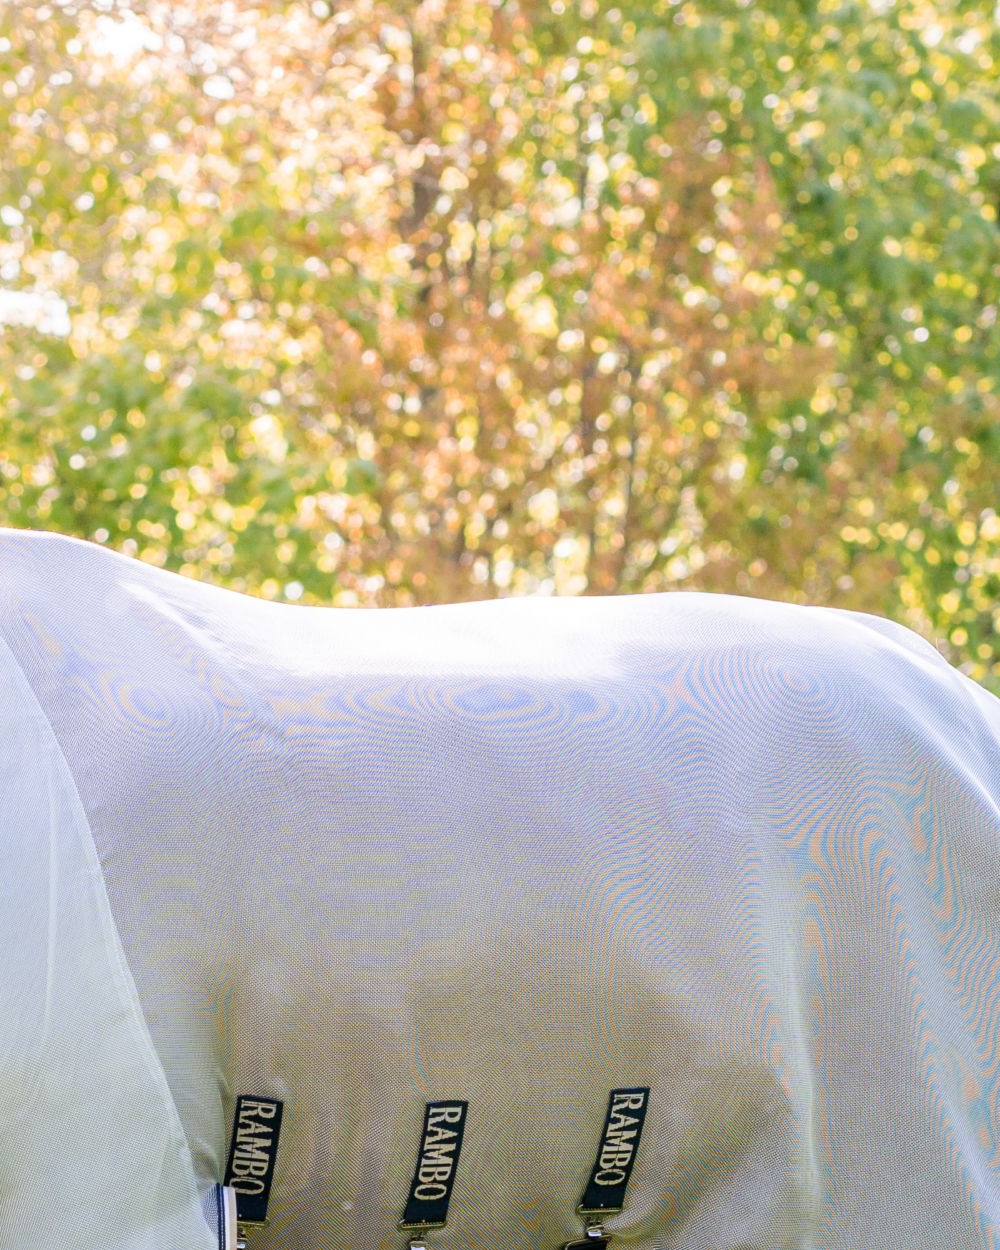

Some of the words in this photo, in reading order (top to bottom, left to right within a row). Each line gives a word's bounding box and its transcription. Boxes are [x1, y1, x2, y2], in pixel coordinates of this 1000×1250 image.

[229, 1100, 277, 1195] RAMBO
[414, 1106, 462, 1200] RAMBO
[594, 1092, 645, 1185] RAMBO
